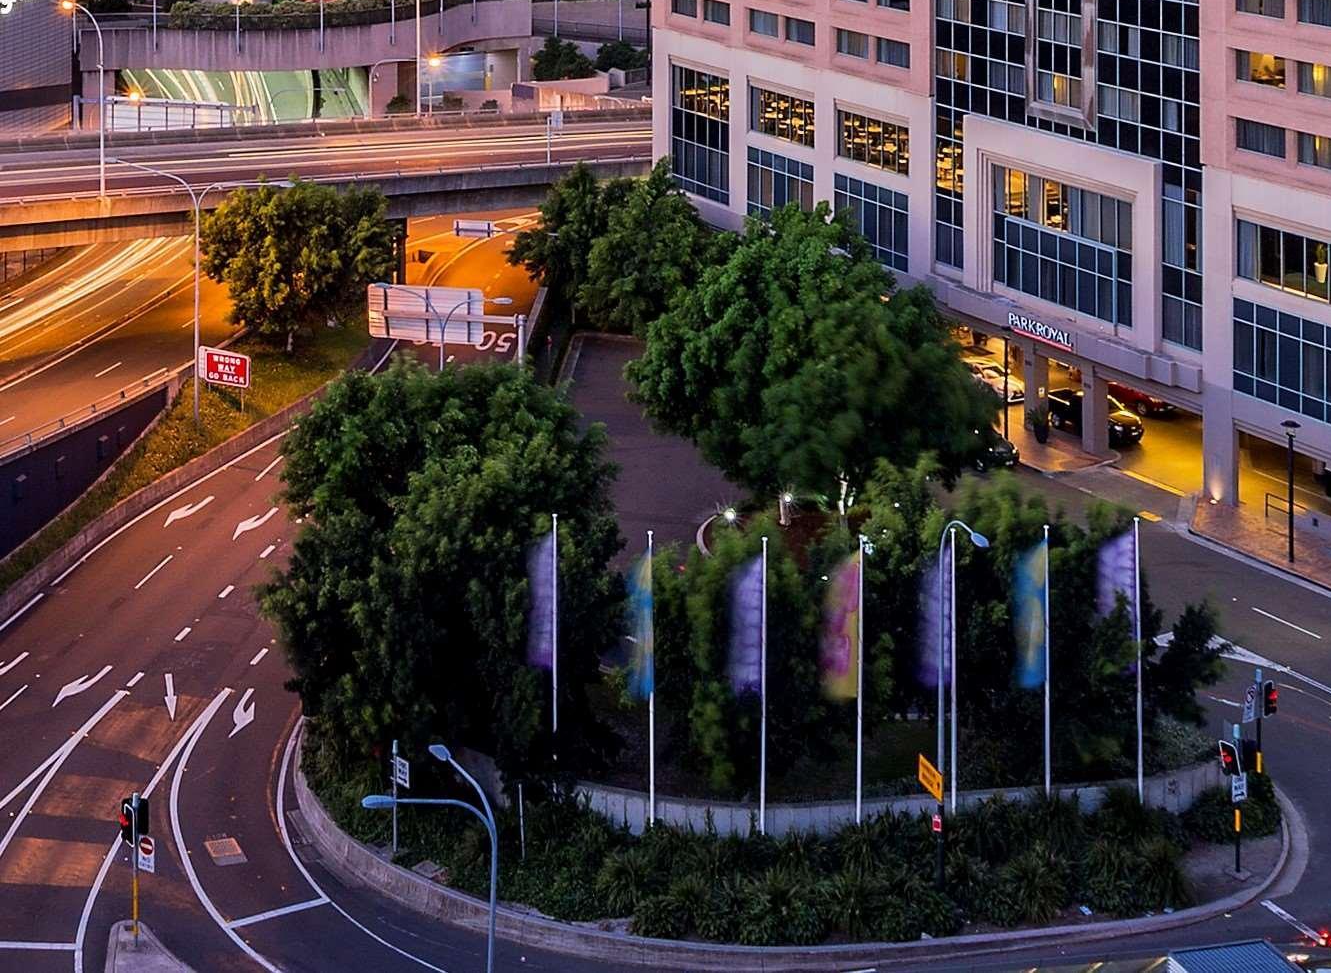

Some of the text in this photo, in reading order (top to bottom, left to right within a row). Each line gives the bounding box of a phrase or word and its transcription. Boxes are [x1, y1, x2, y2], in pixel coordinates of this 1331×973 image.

[1008, 312, 1072, 347] PARKROYAL
[212, 355, 241, 365] WRONG
[217, 363, 236, 373] WAY
[208, 371, 245, 384] GO BACK
